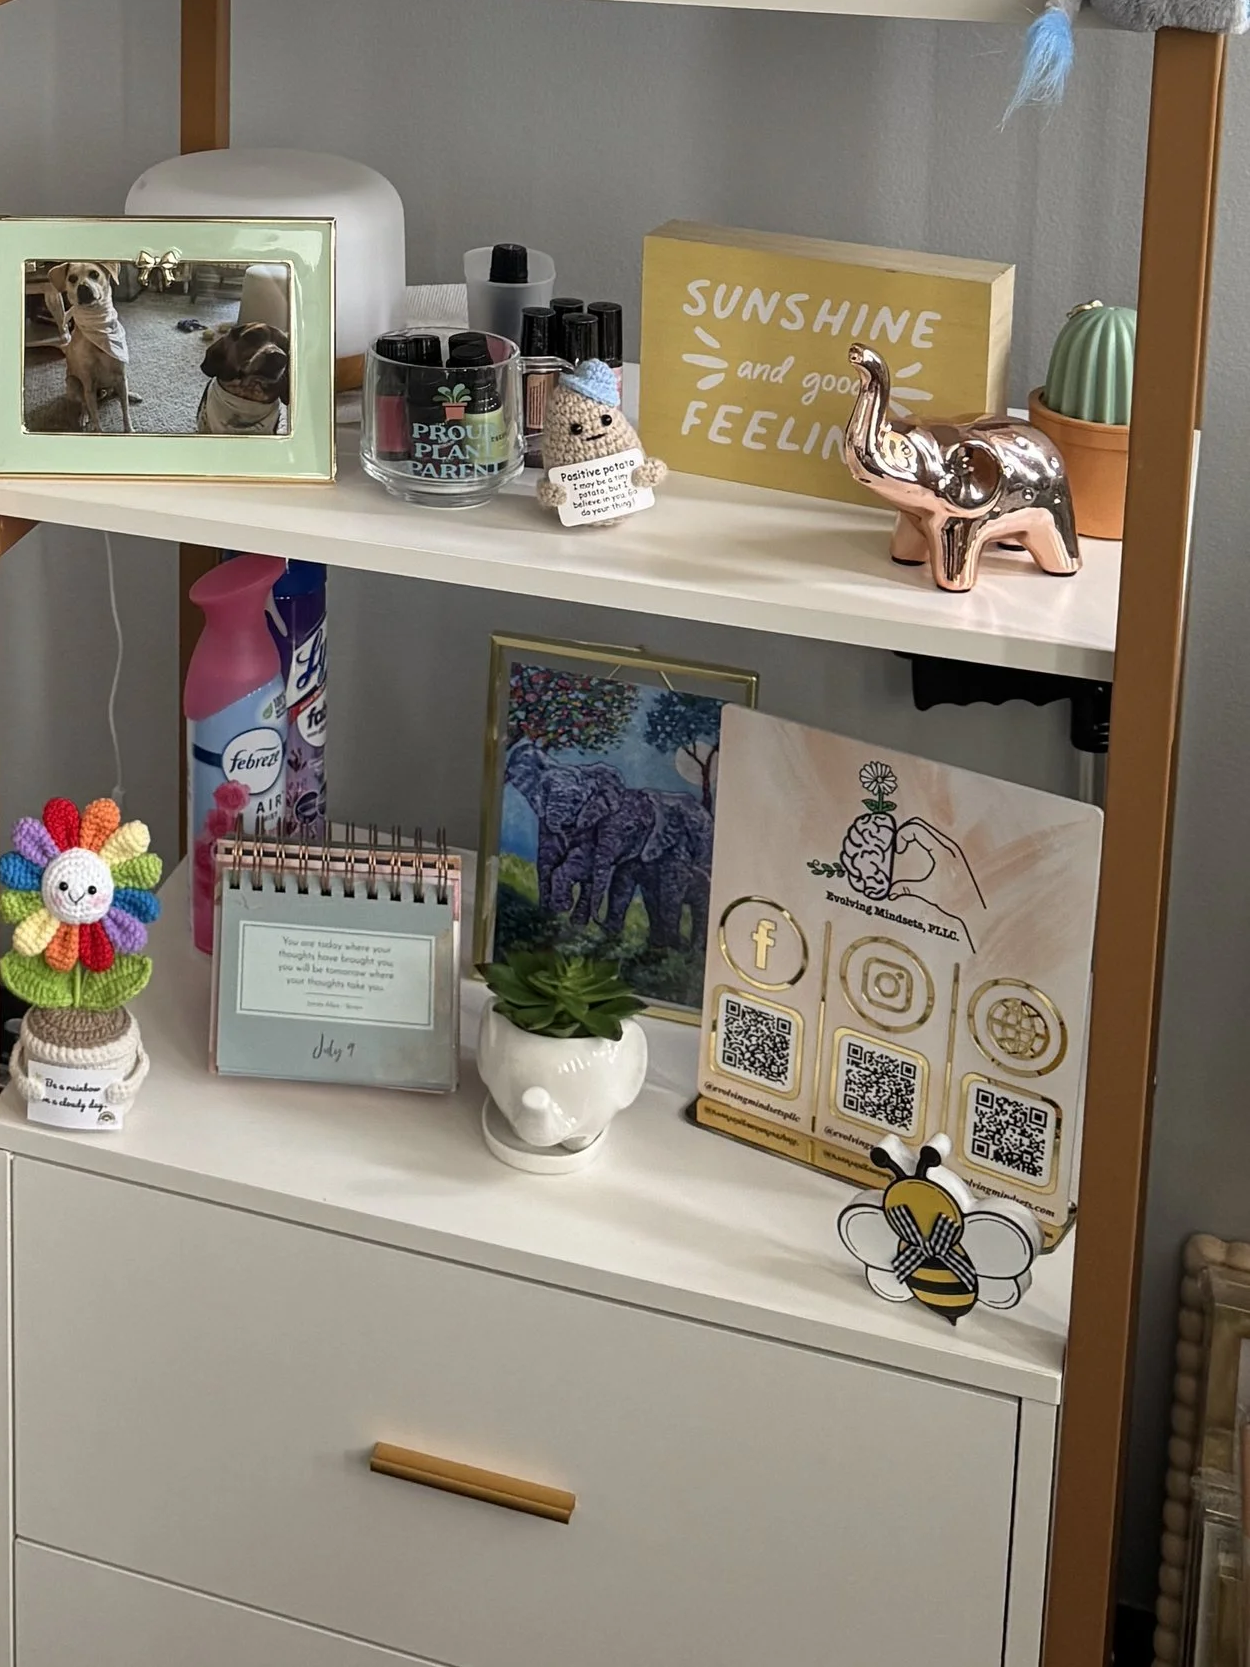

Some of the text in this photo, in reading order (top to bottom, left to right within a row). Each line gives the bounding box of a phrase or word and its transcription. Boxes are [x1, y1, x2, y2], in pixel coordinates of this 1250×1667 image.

[682, 279, 942, 349] SUNSHINE
[737, 356, 795, 383] and
[681, 400, 848, 465] FEELIN
[561, 460, 635, 482] Positive potato
[608, 484, 621, 492] but
[573, 498, 601, 509] believe
[592, 506, 610, 515] your
[612, 498, 636, 510] thing!
[229, 747, 280, 773] febreze
[256, 794, 281, 814] AIR
[825, 891, 960, 942] Evolving Mindsets, PLLC.
[296, 963, 310, 972] will
[312, 964, 322, 973] be
[312, 1032, 356, 1063] July 9
[45, 1078, 57, 1089] Be
[66, 1083, 101, 1092] rainbow
[59, 1097, 86, 1113] cloudy
[704, 1081, 801, 1123] @evolvingmindsetspllc
